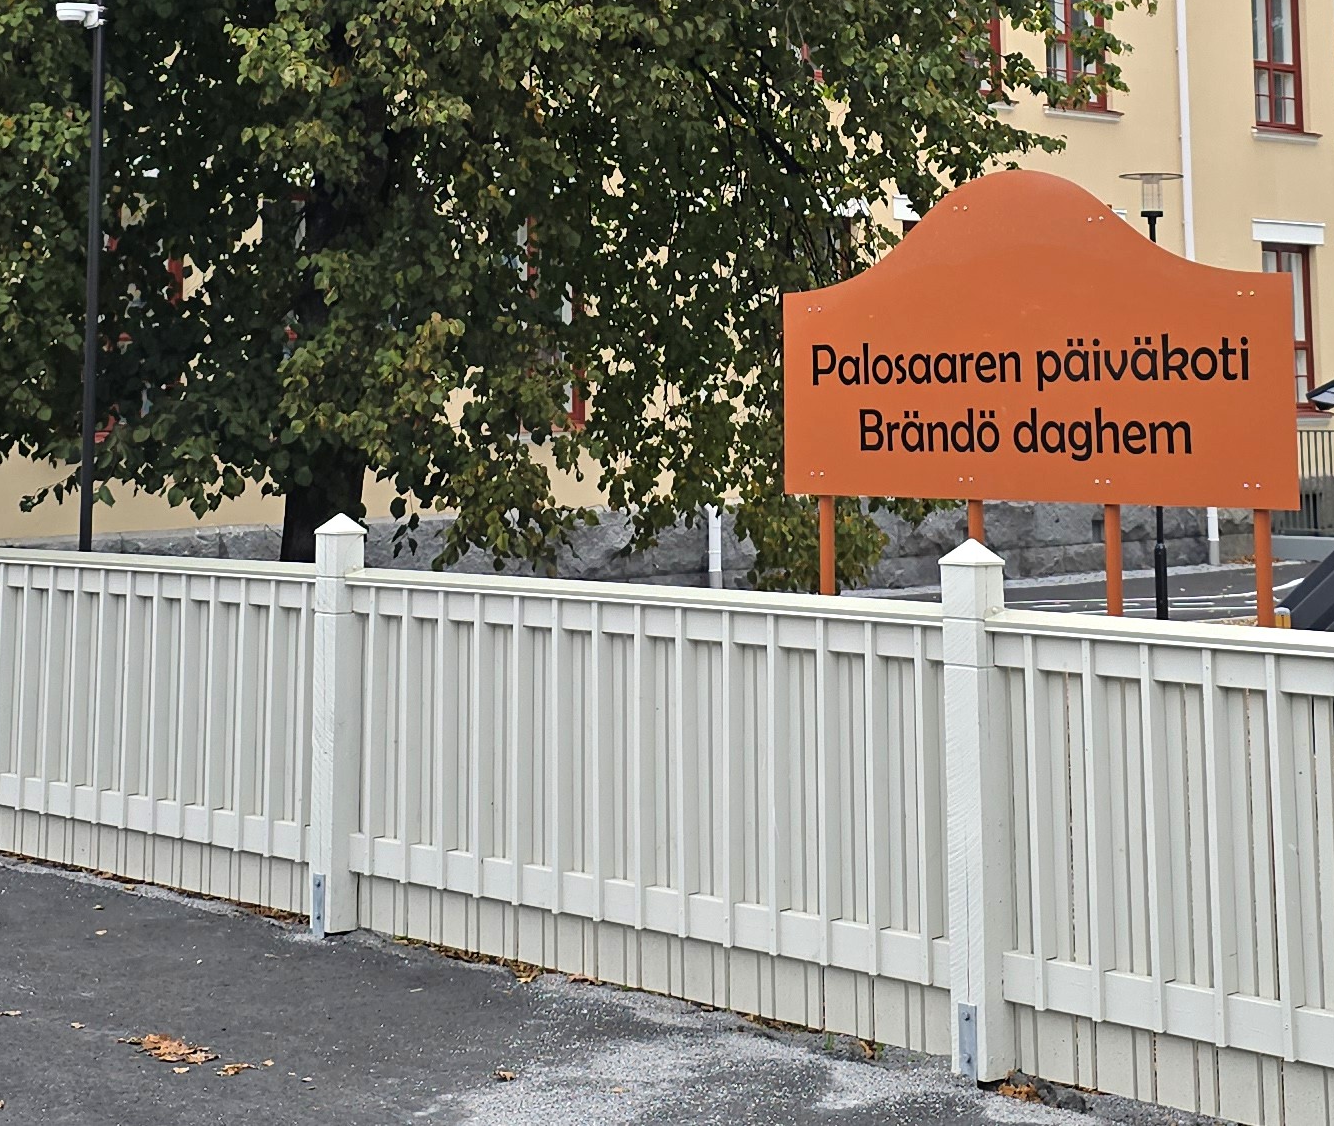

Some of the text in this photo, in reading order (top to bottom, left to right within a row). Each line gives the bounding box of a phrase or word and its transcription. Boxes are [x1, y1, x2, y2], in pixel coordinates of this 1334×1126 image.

[811, 333, 1250, 392] Palosaaren päiväkoti
[858, 407, 1193, 462] Brändö daghem
